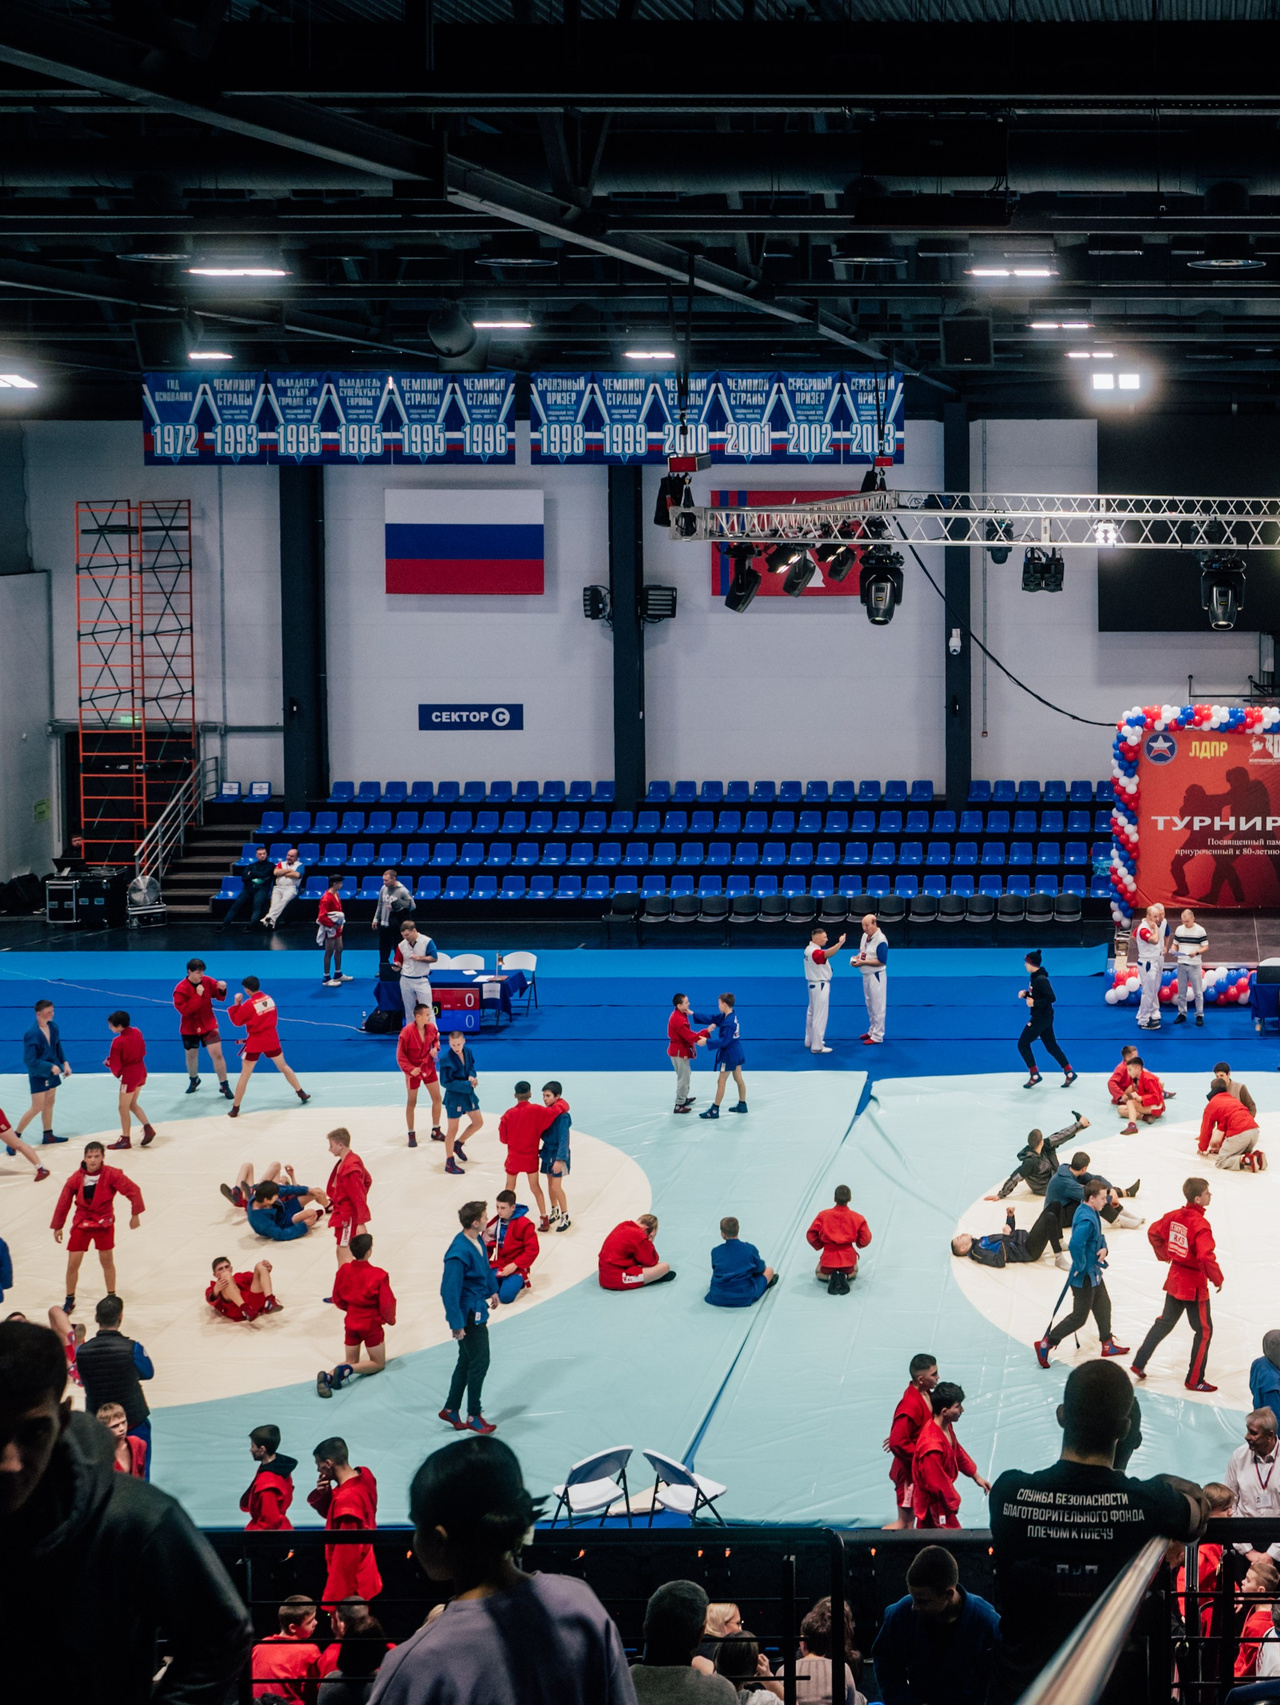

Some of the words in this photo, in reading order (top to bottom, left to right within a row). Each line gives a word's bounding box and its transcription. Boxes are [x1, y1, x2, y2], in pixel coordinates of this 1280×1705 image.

[213, 379, 256, 391] ЧЕМПИОН
[401, 378, 443, 391] ЧЕМПИОН
[464, 378, 505, 391] ЧЕМПИОН
[537, 376, 585, 391] БРОНЗОВЫЙ
[603, 378, 645, 391] ЧЕМПИОН
[726, 378, 769, 391] ЧЕМПИОН
[788, 376, 832, 390] СЕРЕБРЯНЫЙ
[217, 393, 253, 406] СТРАНЫ
[405, 393, 440, 406] СТРАНЫ
[467, 393, 502, 406] СТРАНЫ
[547, 392, 576, 405] ПРИЗЕР
[606, 393, 642, 406] СТРАНЫ
[730, 392, 766, 405] СТРАНЫ
[796, 392, 825, 404] ПРИЗЕР
[153, 424, 197, 454] 1972
[214, 424, 258, 454] 1993
[278, 424, 321, 454] 1995
[339, 424, 383, 454] 1995
[401, 424, 445, 454] 1995
[463, 424, 506, 454] 1996
[540, 424, 585, 454] 1998
[603, 424, 647, 454] 1999
[664, 424, 709, 454] 2000
[727, 424, 771, 453] 2001
[788, 424, 832, 453] 2002
[851, 424, 895, 453] 2003
[431, 712, 490, 722] СЕКТОР
[1189, 741, 1228, 759] ЛДПР
[1208, 838, 1264, 846] Посвященный
[1175, 848, 1233, 856] приуроченный
[464, 993, 474, 1008] 0
[466, 1015, 474, 1028] 0
[1017, 1488, 1053, 1504] СЛУЖБА
[1055, 1492, 1128, 1506] БЕЗОПАСНОСТИ
[1003, 1503, 1108, 1523] БЛАГОТВОРИТЕЛЬНОГО
[1110, 1509, 1145, 1523] ФОНДА
[1027, 1525, 1069, 1539] ПЛЕЧОМ
[1071, 1527, 1078, 1539] К
[1080, 1528, 1113, 1540] ПЛЕЧУ
